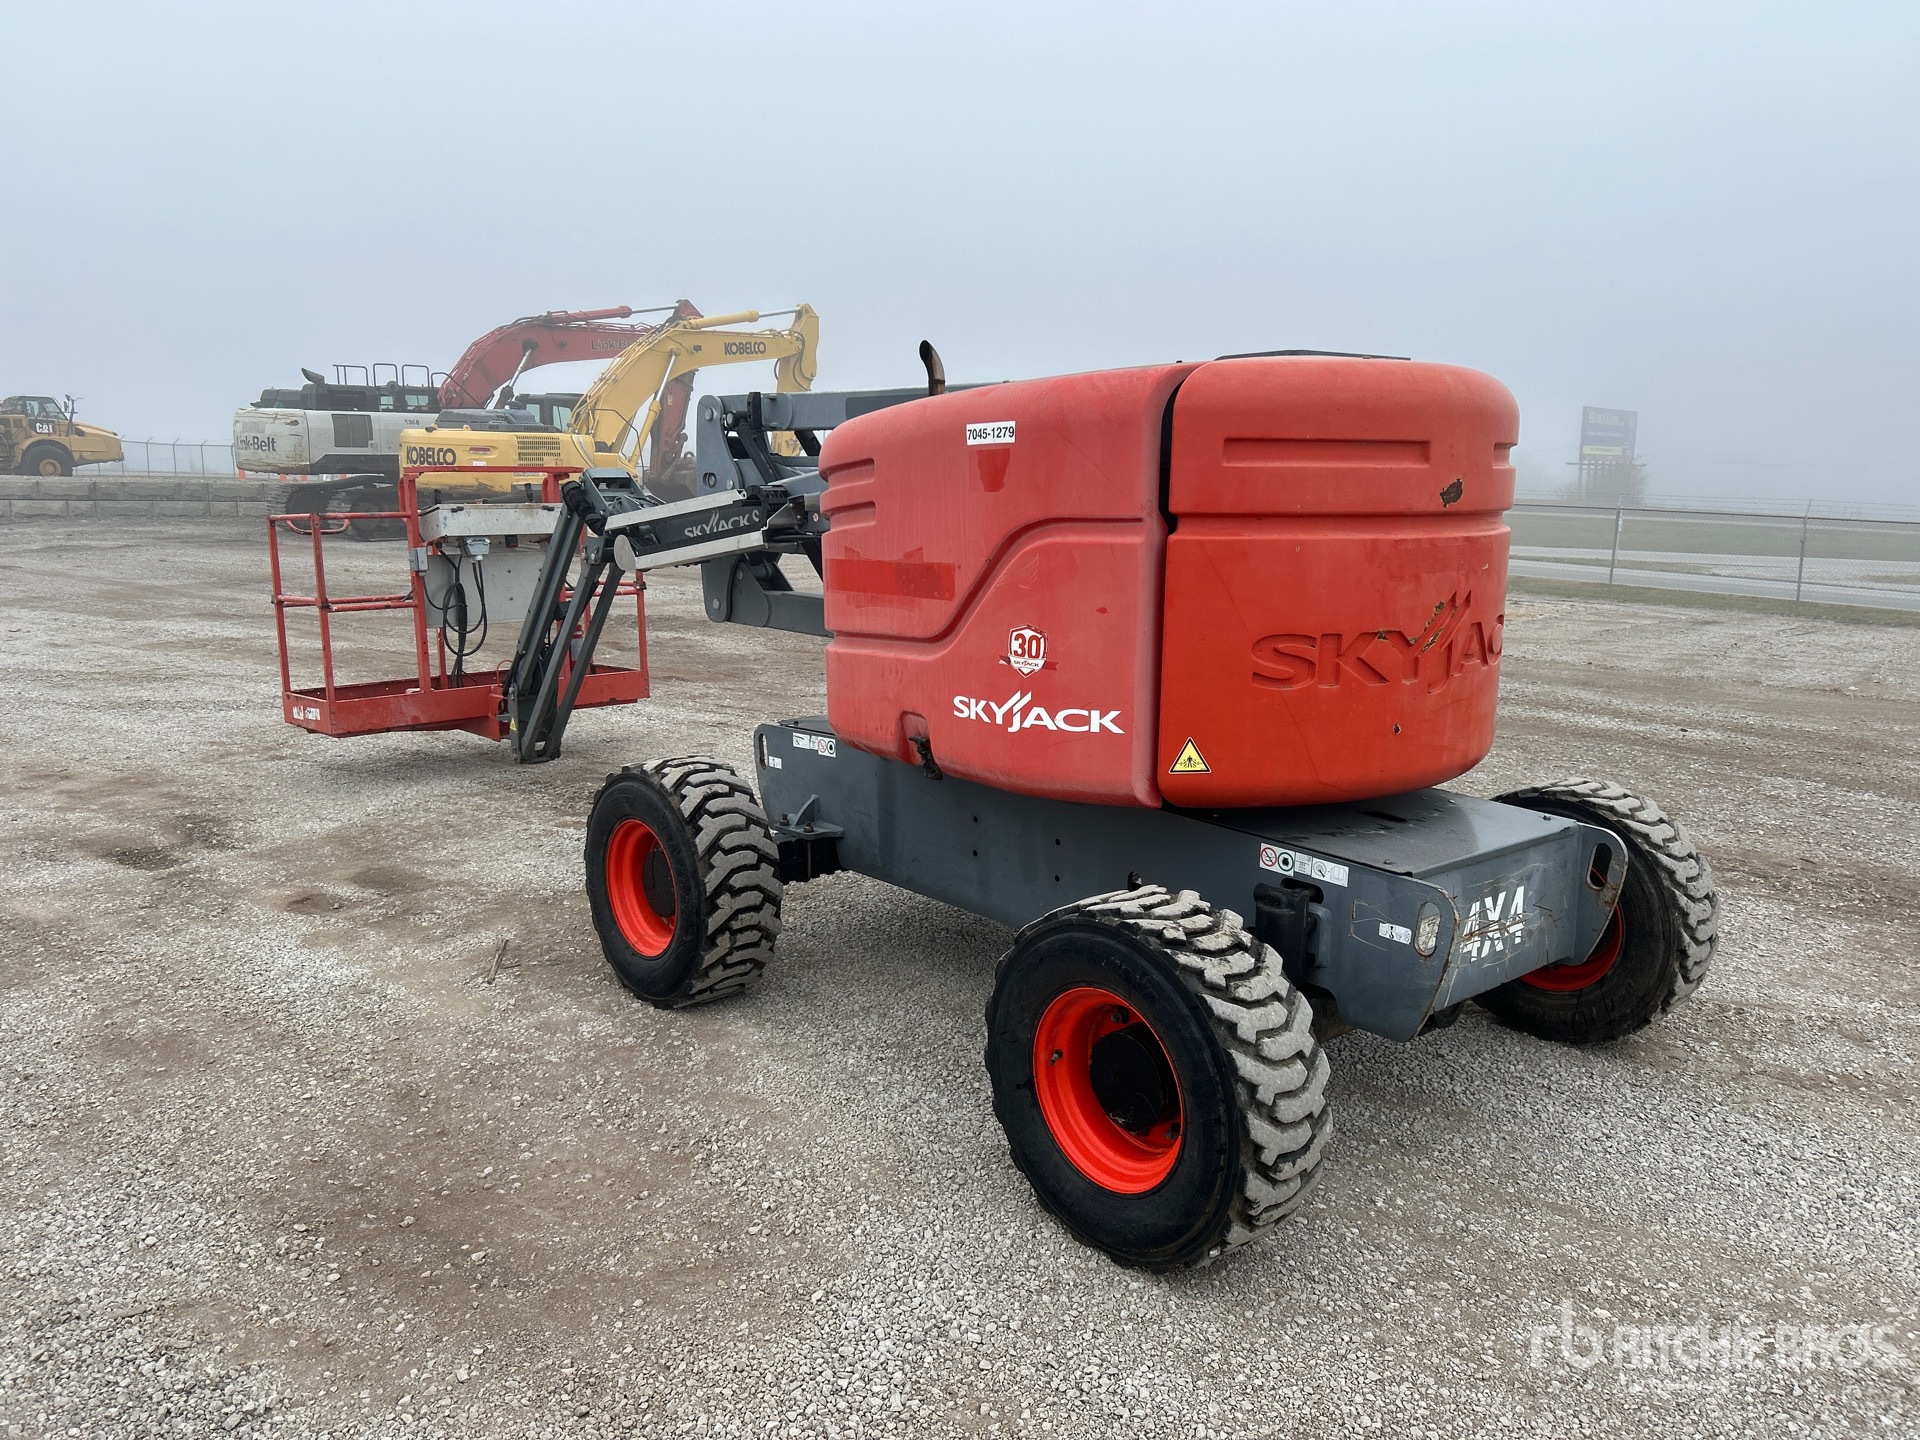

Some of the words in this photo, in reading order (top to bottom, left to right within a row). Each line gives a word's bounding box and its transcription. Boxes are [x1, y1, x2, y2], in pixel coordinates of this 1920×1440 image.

[591, 338, 632, 350] Link-B
[723, 341, 767, 356] KOBELCO
[35, 422, 53, 434] CAT
[967, 426, 1015, 440] 7045-1279
[406, 446, 457, 466] KOBELCO
[1013, 632, 1041, 659] 30
[953, 690, 1126, 734] SKYJACK
[1459, 886, 1525, 963] 4X4
